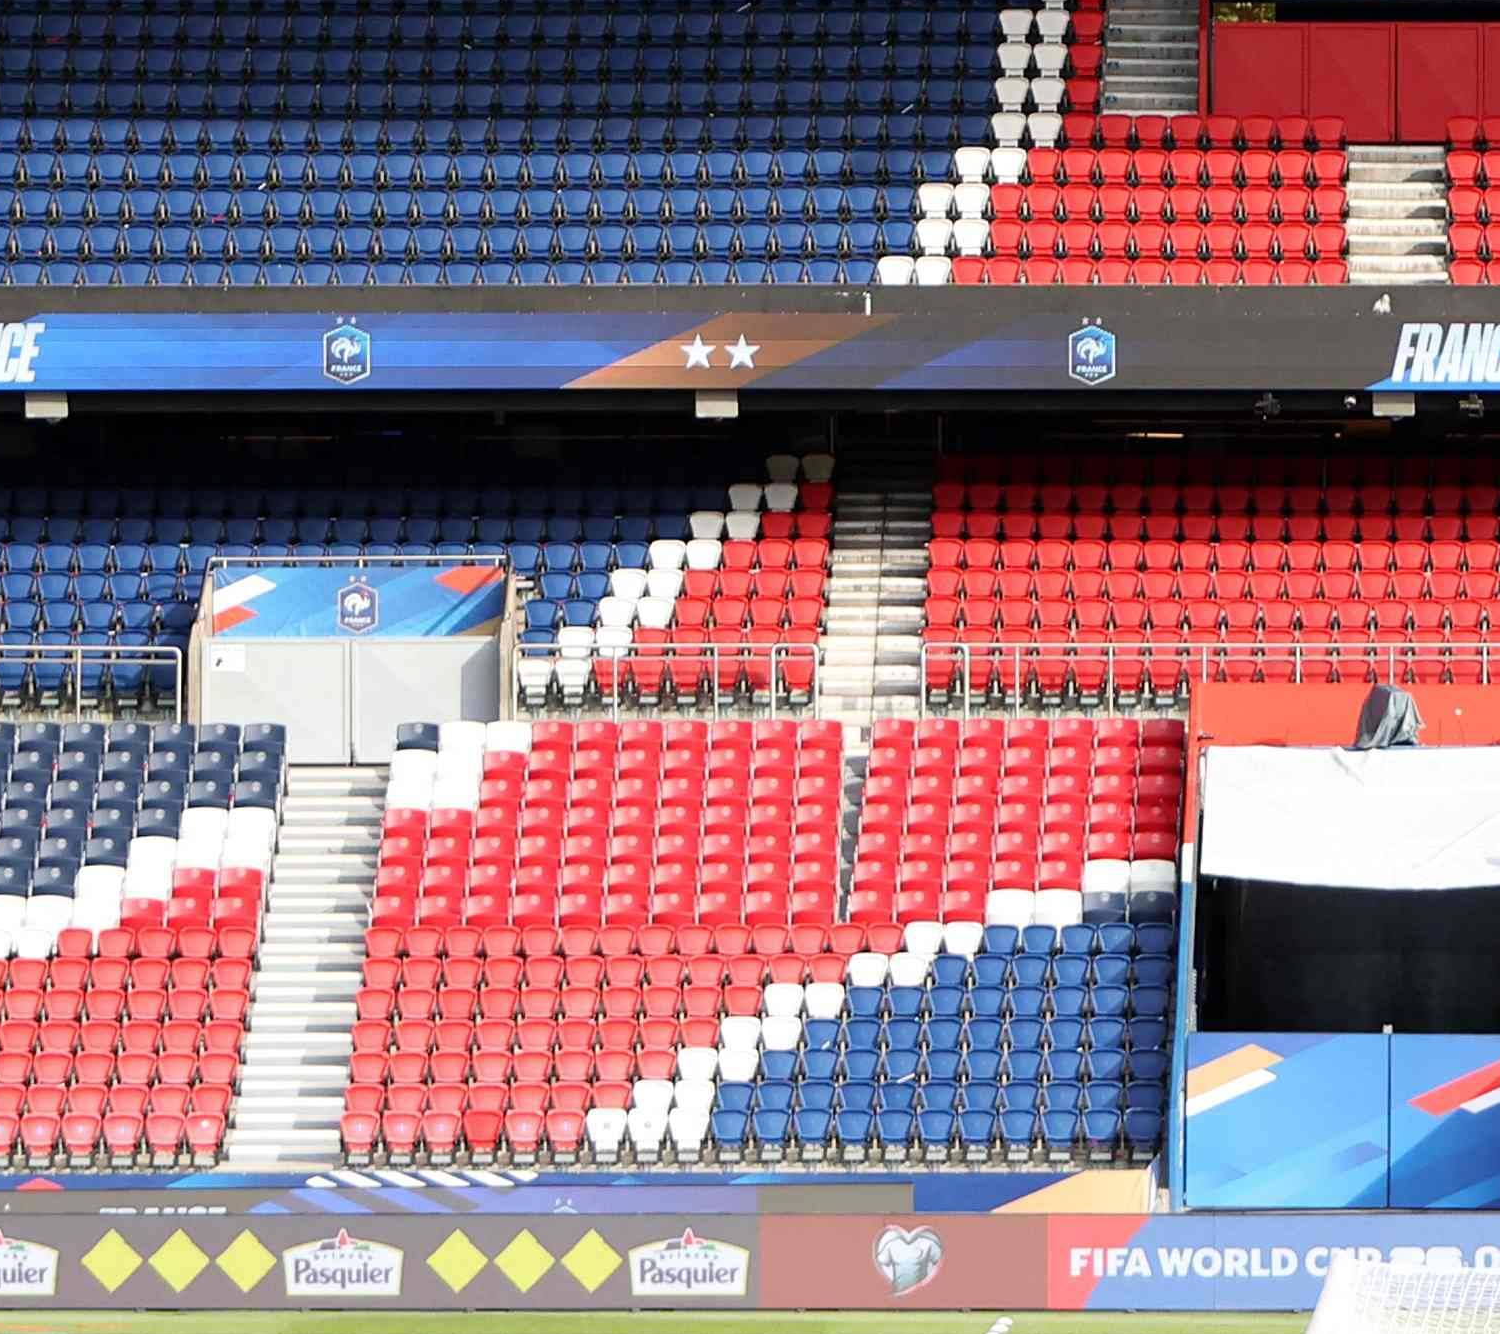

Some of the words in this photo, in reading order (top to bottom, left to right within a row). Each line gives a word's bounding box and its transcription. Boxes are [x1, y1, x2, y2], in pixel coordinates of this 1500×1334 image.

[294, 1258, 394, 1289] Pasquier
[639, 1258, 740, 1289] Pasquier
[1070, 1247, 1152, 1278] FIFA
[1156, 1247, 1298, 1278] WORLD
